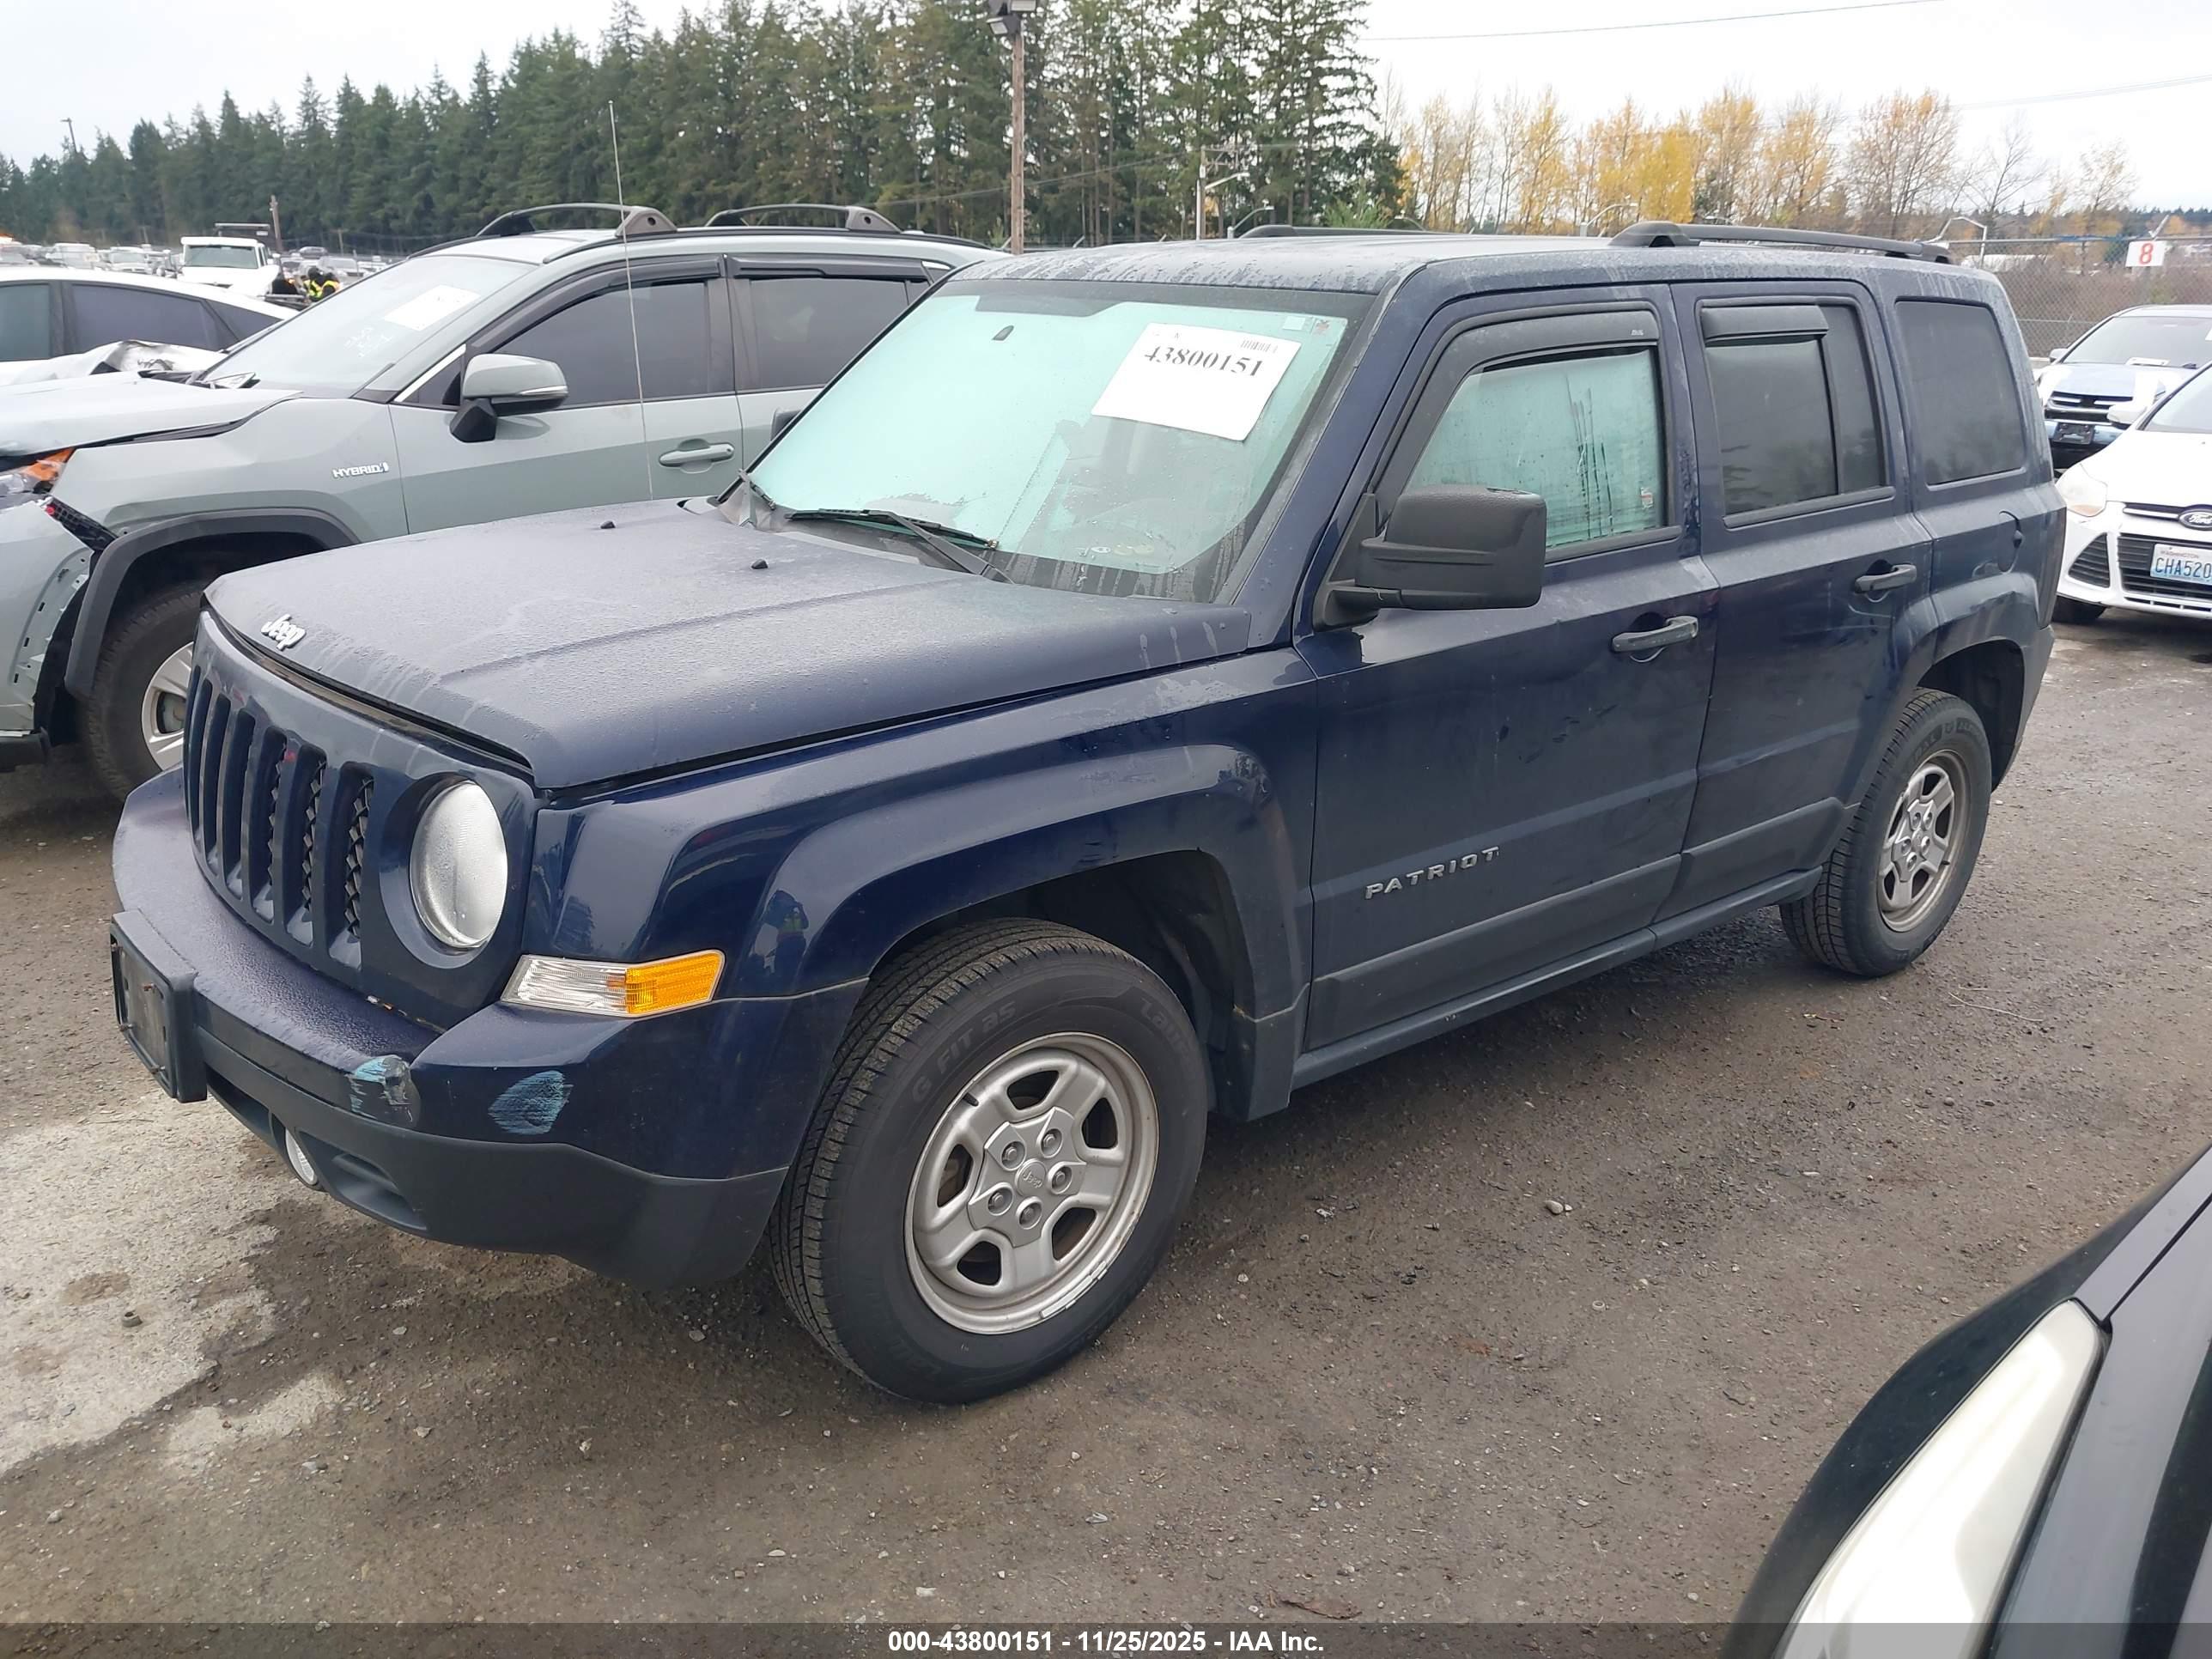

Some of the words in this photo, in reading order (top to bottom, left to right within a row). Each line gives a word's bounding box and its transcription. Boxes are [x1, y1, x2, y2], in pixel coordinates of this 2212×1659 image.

[2140, 243, 2154, 264] 8
[1144, 345, 1263, 376] 43800151
[331, 464, 384, 477] HYBRID
[2154, 556, 2212, 579] CHA520
[260, 613, 307, 650] Jeep
[1364, 845, 1499, 900] PATRIOT
[937, 1027, 974, 1075] FIT
[1022, 1165, 1043, 1189] Jeep
